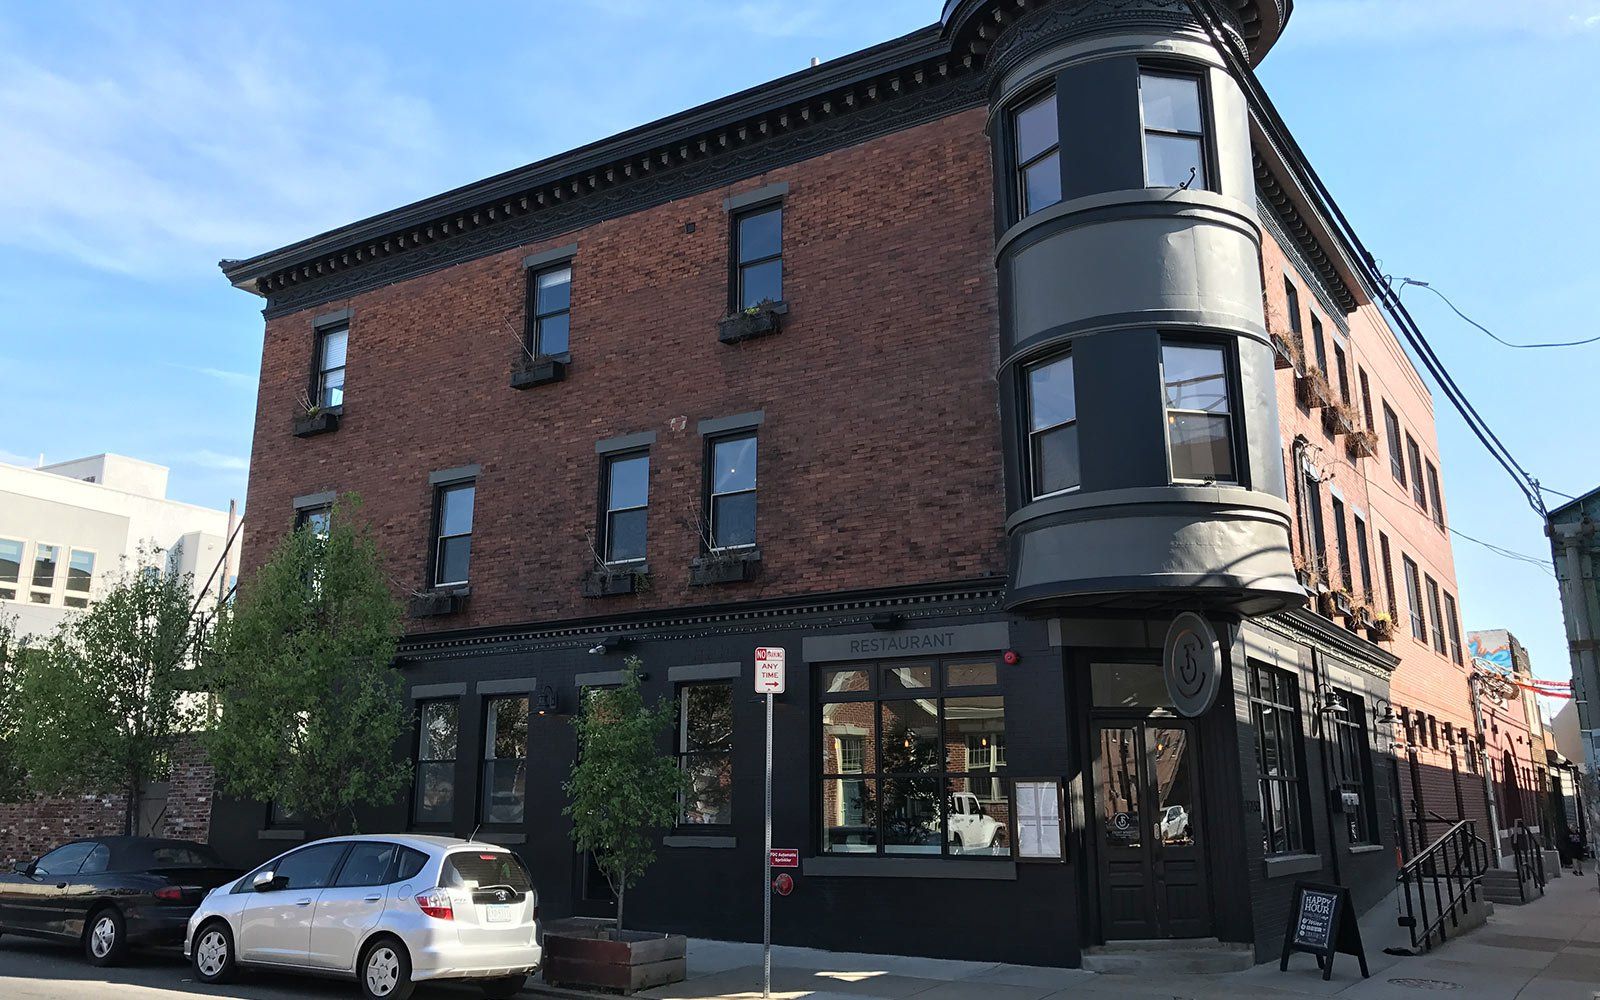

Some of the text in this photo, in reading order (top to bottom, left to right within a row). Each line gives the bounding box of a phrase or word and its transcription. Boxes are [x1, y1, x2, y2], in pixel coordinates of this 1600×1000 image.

[850, 632, 954, 653] RESTAURANT
[757, 650, 766, 660] NO
[761, 671, 779, 679] TIME
[1306, 896, 1331, 907] HAPPY
[1305, 903, 1329, 914] HOUR
